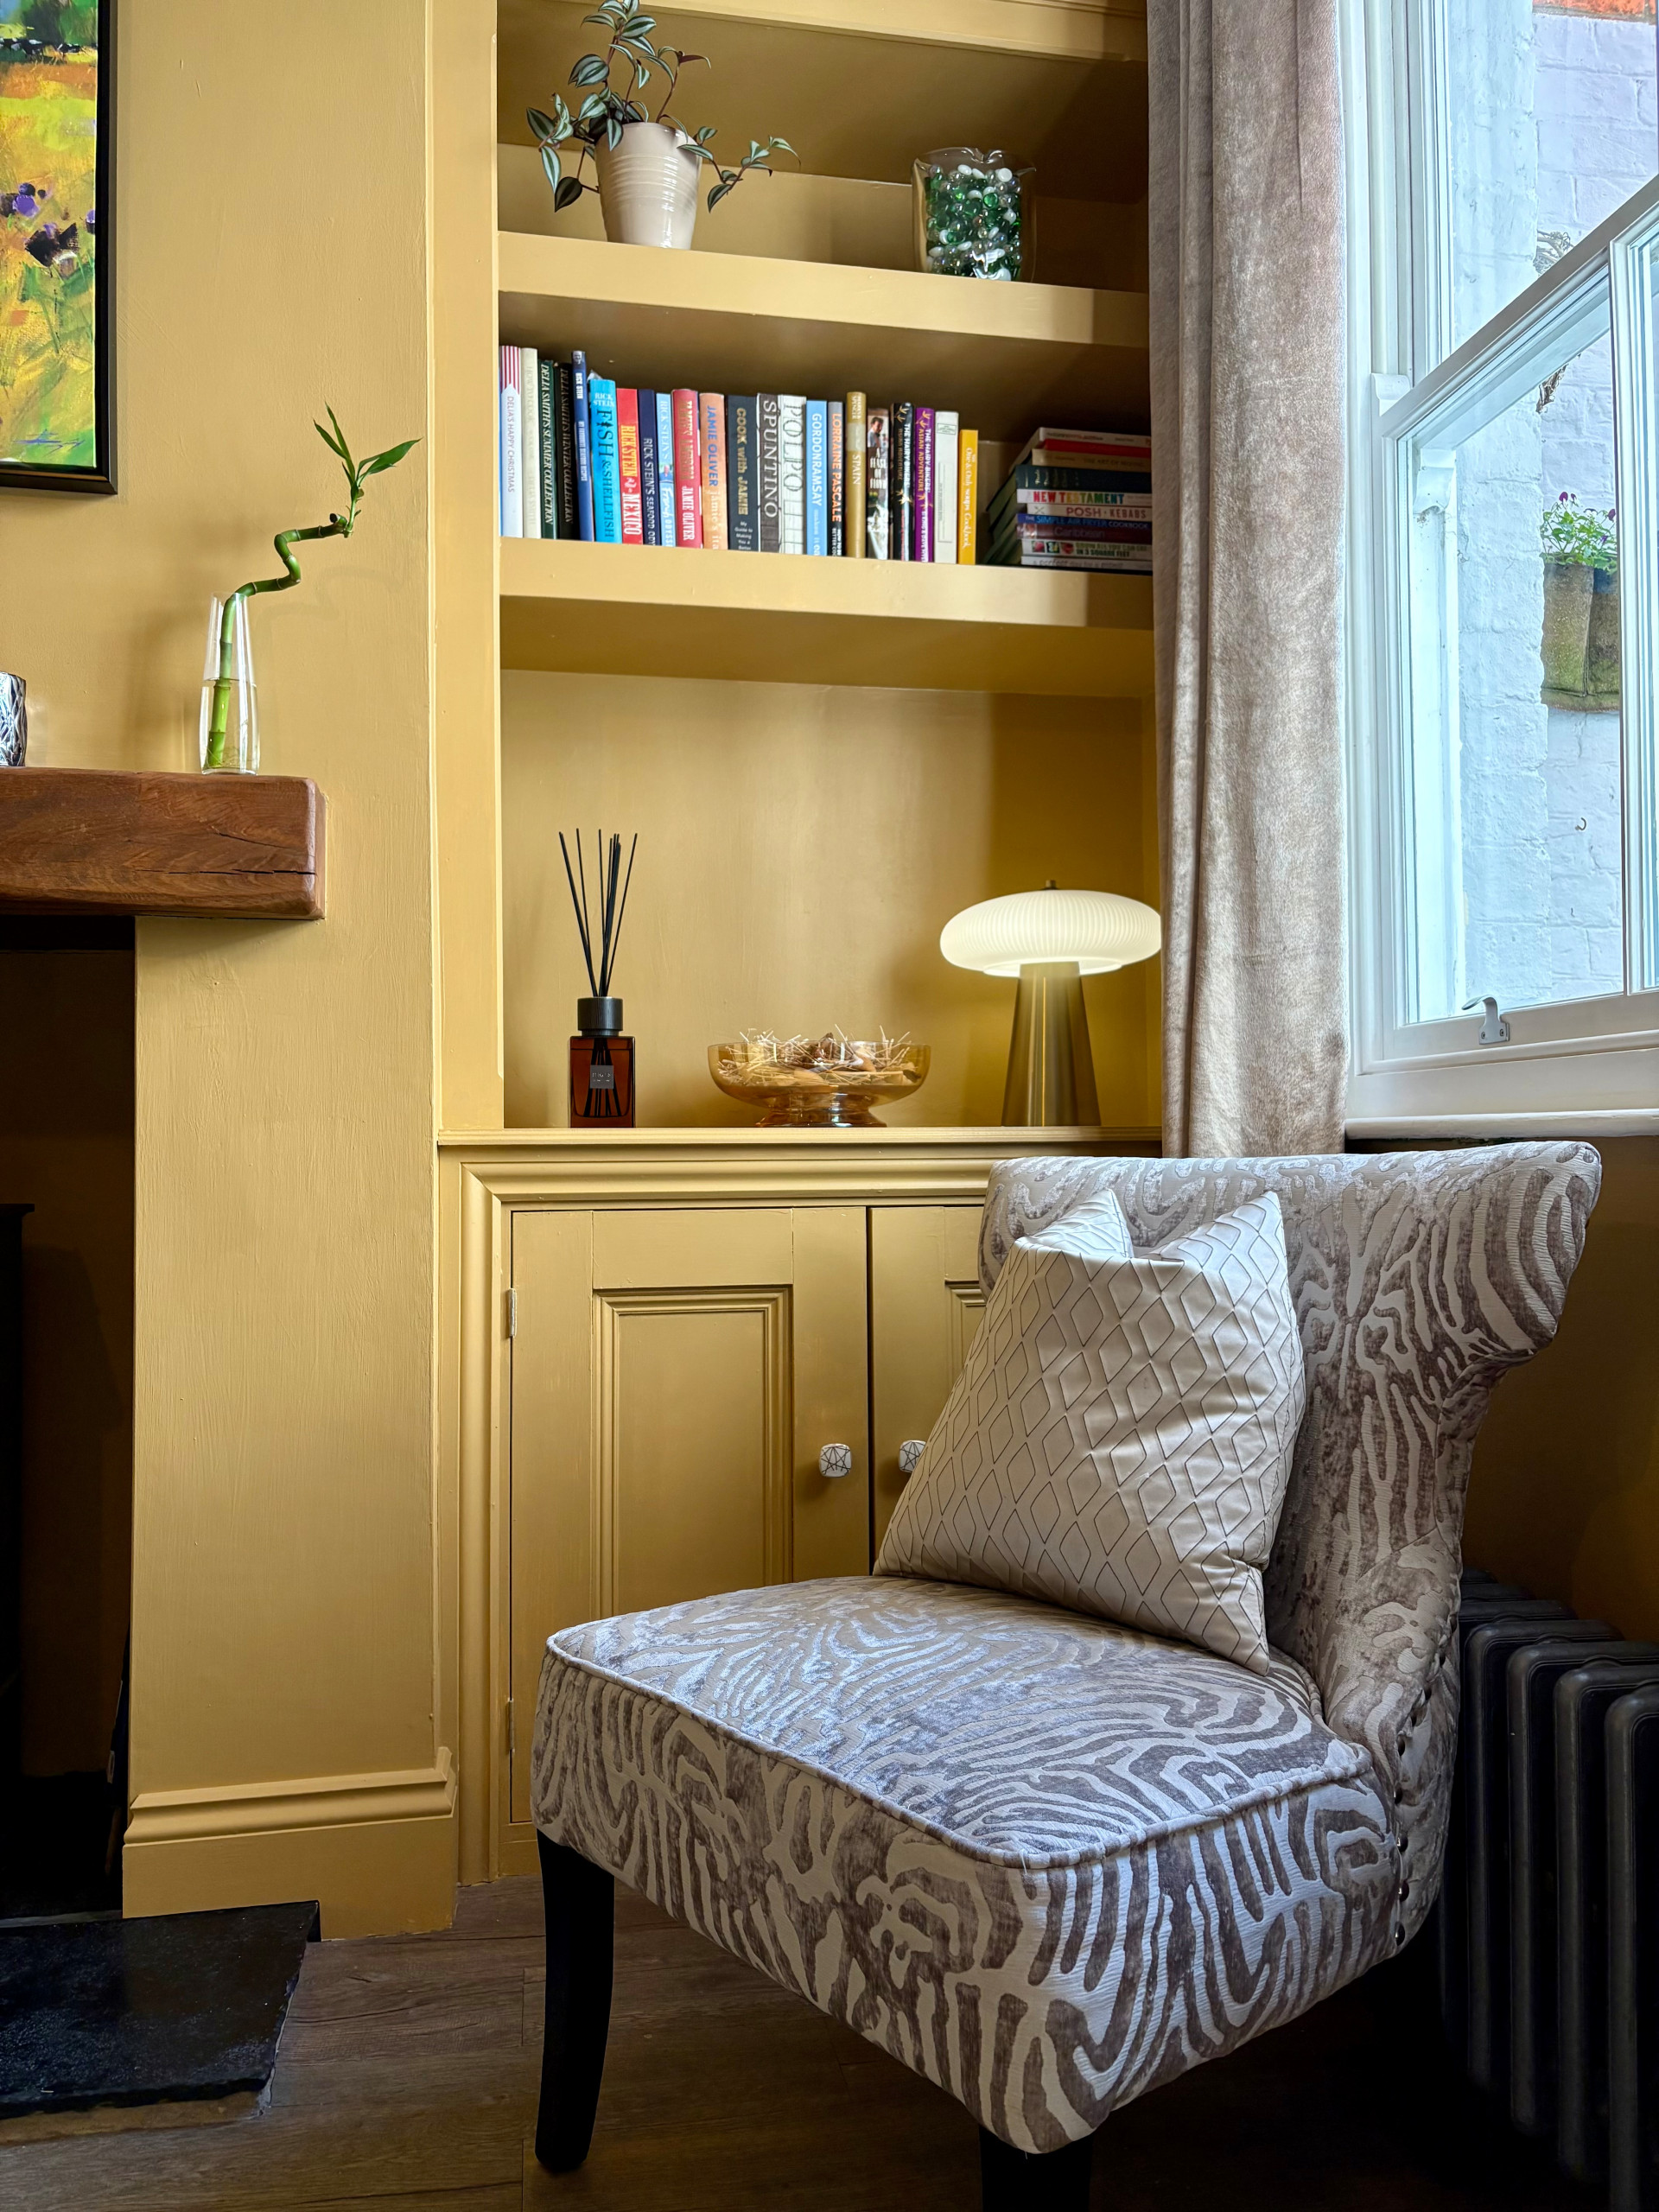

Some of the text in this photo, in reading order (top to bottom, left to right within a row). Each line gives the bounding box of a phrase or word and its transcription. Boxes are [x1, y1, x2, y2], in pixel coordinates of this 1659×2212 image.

[560, 368, 570, 397] DELIA
[575, 372, 583, 385] RICK
[575, 385, 584, 400] STEIN
[593, 399, 614, 408] STEIN
[660, 400, 670, 423] RICK
[507, 395, 517, 493] DELIA'S HAPPY CHRISTMAS
[540, 363, 555, 524] DELIA SMITH'S SUMMER COLLECTION
[620, 424, 636, 448] RICK
[660, 423, 671, 461] STEIN'S
[707, 404, 719, 486] JAMIE OLIVER
[903, 423, 912, 437] THE
[563, 432, 573, 467] WINTER
[621, 448, 639, 477] STEIN
[644, 437, 653, 460] RICK
[736, 407, 748, 516] COOK with JAMIE
[764, 400, 778, 518] SPUNTINO
[783, 404, 804, 493] POLPO
[810, 412, 823, 507] GORDONRAMSAY
[644, 461, 655, 495] STEIN'S
[831, 412, 842, 523] LORRAINE PASCALE
[851, 454, 862, 486] SPAIN
[563, 469, 575, 524] COLLECTION
[601, 470, 614, 538] SHELLFISH
[645, 496, 655, 530] SEAFOOD
[682, 486, 695, 511] JAMIE
[1033, 491, 1057, 502] NEW
[1058, 492, 1124, 505] TESTAMENT
[1065, 506, 1147, 519] POSH KEBABS
[621, 492, 643, 536] MEXICO
[683, 512, 696, 541] OLIVER
[1035, 515, 1065, 525] SIMPLE
[1108, 521, 1148, 530] COOKBOOK
[962, 512, 972, 550] Cookbook
[1053, 526, 1106, 539] Caribbean
